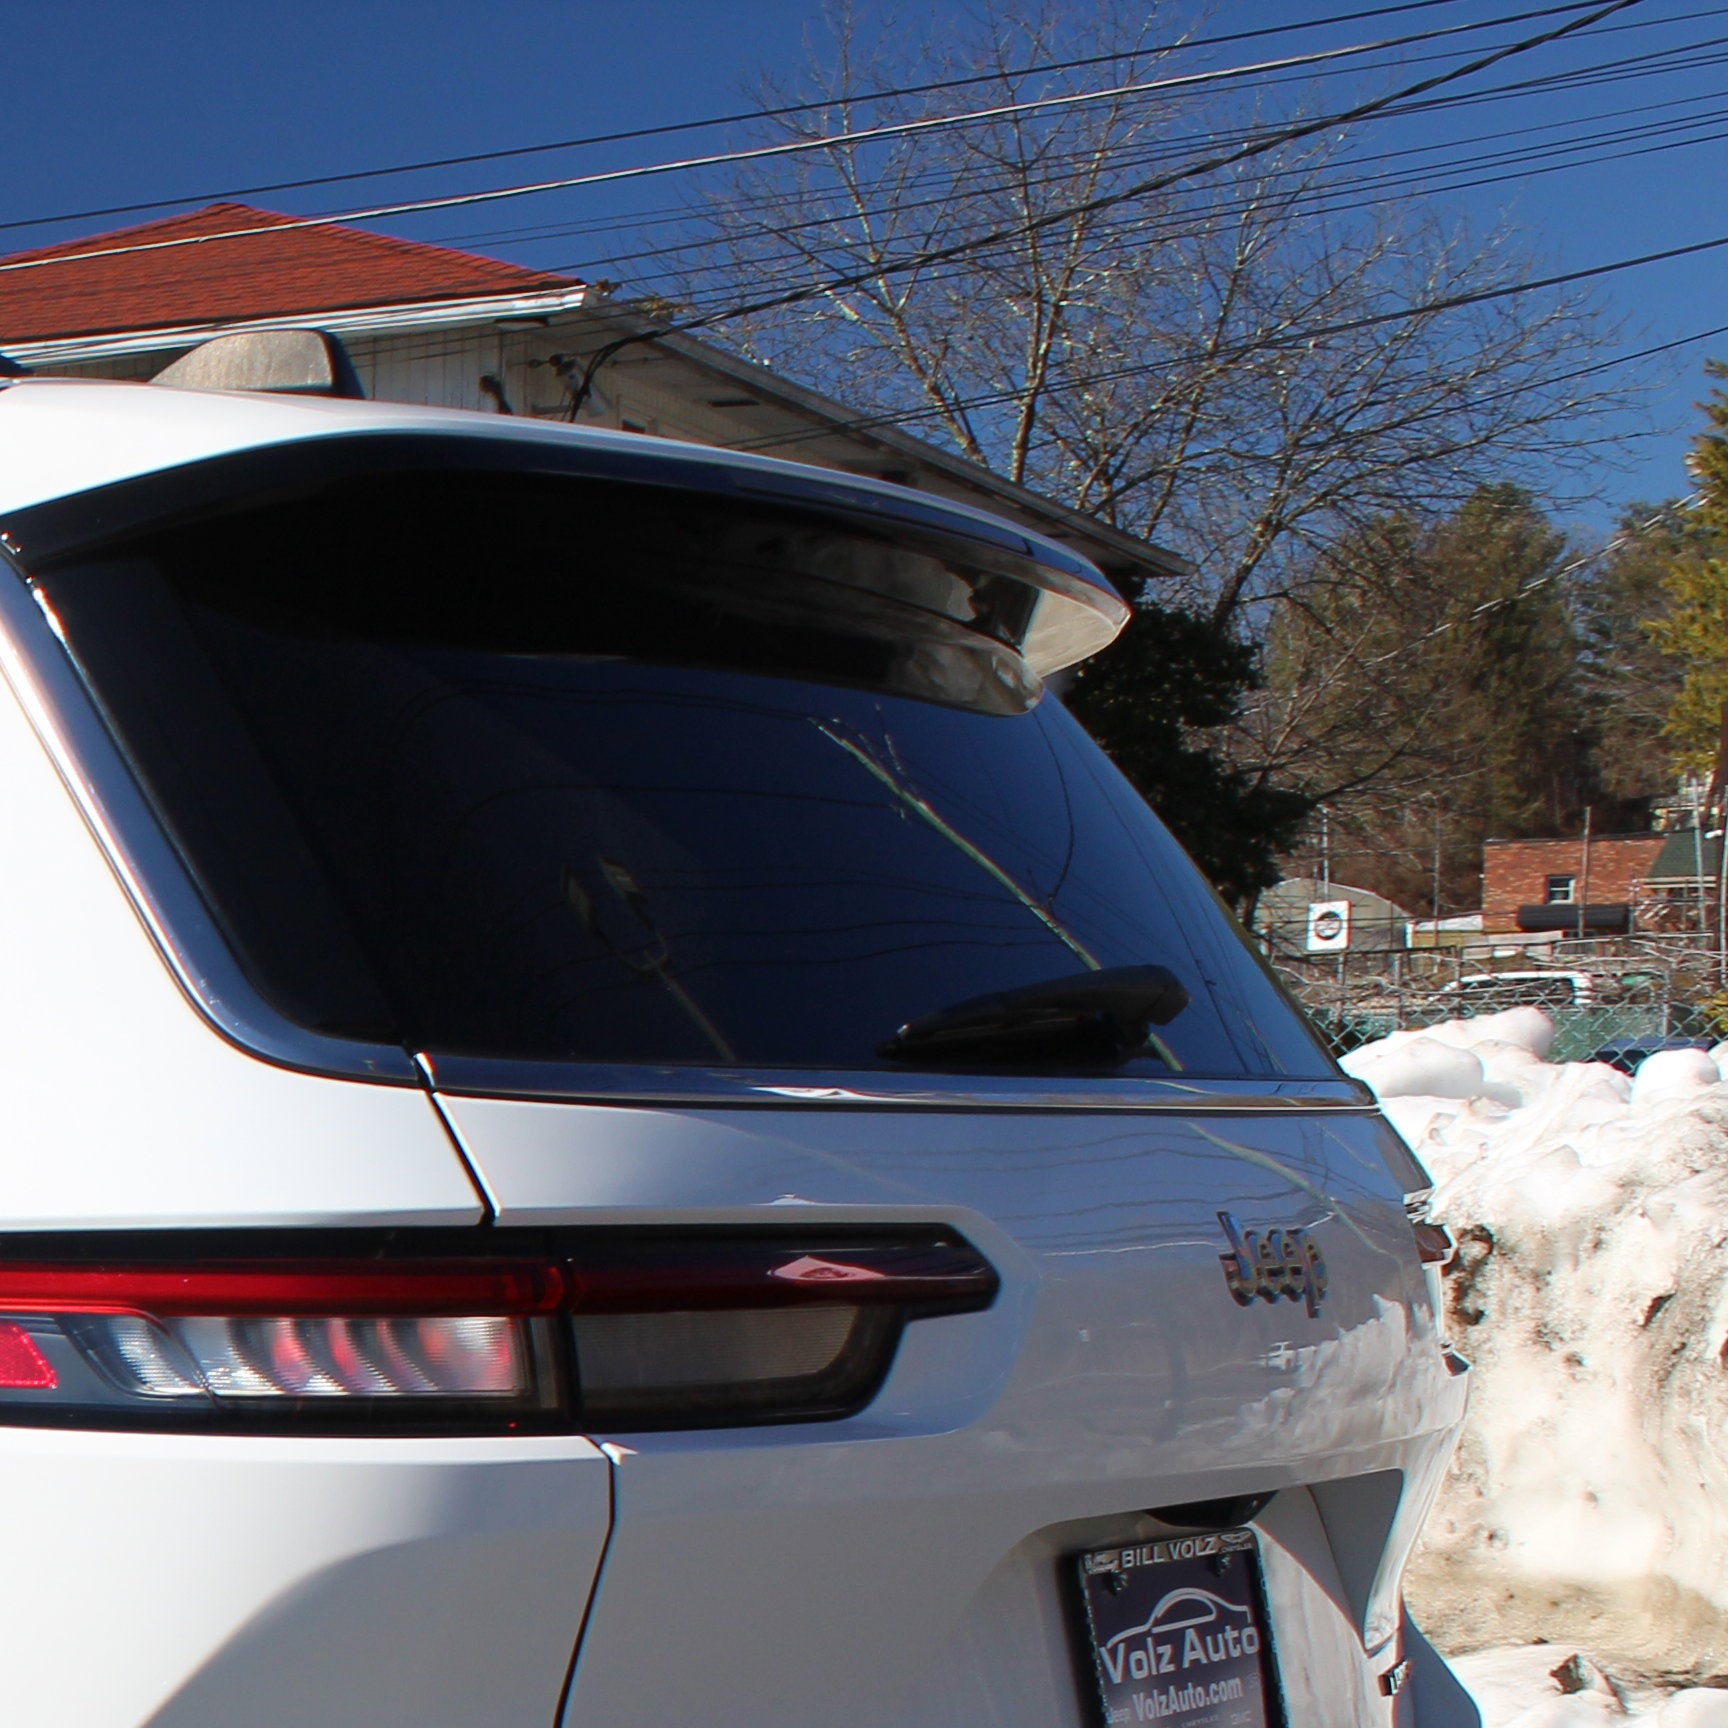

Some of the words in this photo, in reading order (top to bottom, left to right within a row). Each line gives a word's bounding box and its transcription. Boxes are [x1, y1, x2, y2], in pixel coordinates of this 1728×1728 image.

[1216, 1211, 1328, 1318] Jeep
[1121, 1545, 1164, 1569] BILL
[1168, 1537, 1217, 1560] VOLZ
[1100, 1636, 1175, 1685] Volz
[1181, 1625, 1260, 1669] Auto
[1132, 1676, 1243, 1722] VolzAuto.com
